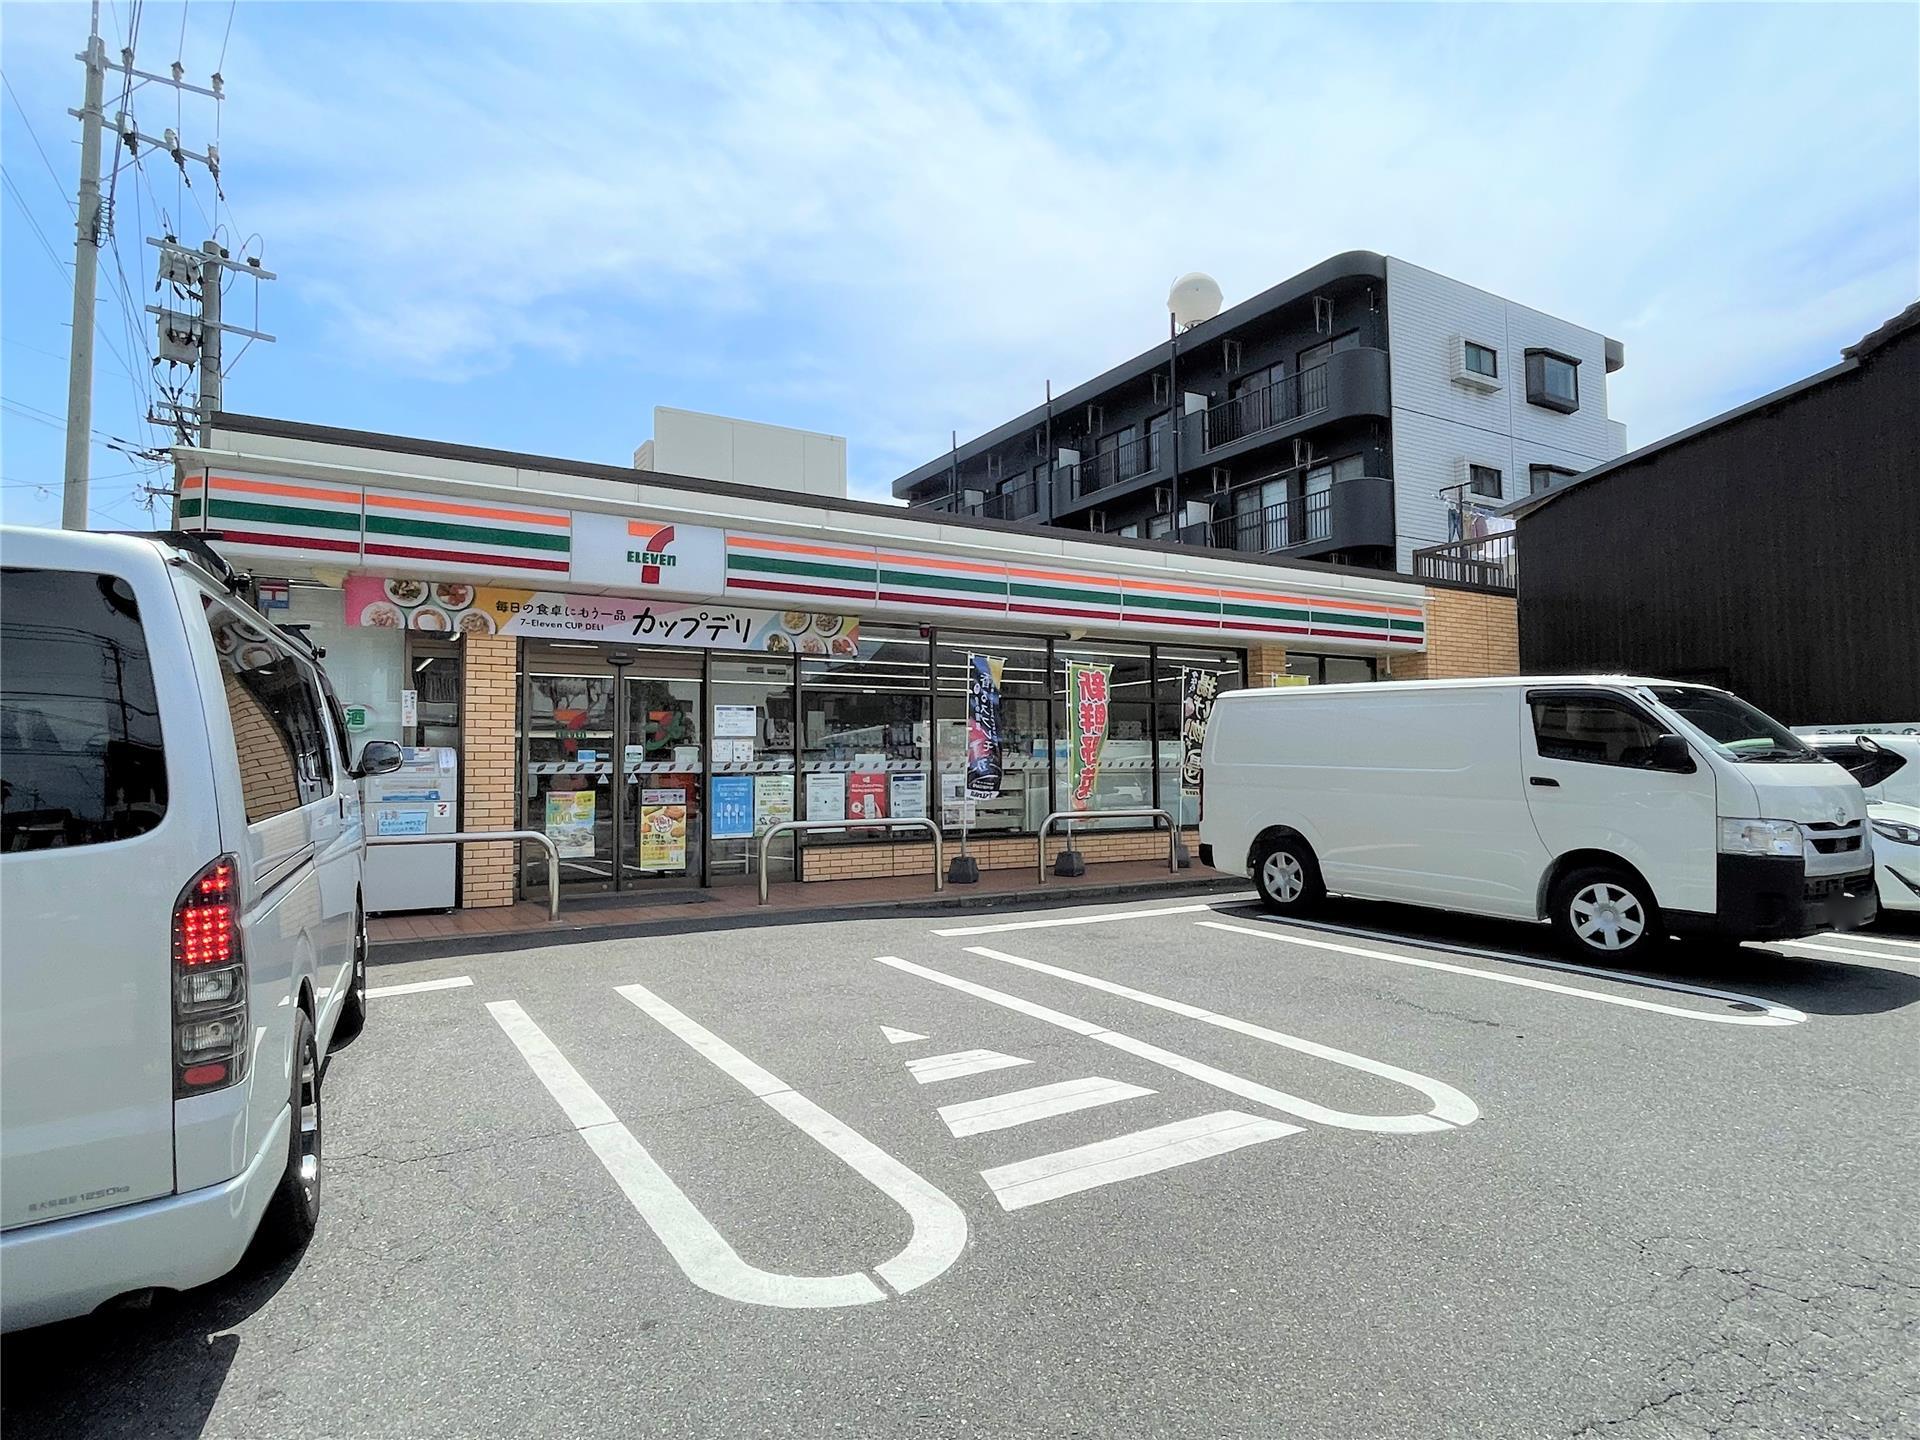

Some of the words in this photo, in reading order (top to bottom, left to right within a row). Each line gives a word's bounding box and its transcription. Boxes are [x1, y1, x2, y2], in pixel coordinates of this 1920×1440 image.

[496, 600, 626, 621] 毎日の食卓にもう一品
[520, 618, 563, 629] 7-Eleven
[564, 621, 583, 630] CUP
[585, 623, 604, 631] DELI
[632, 607, 751, 643] カップデリ
[346, 708, 366, 725] 酒
